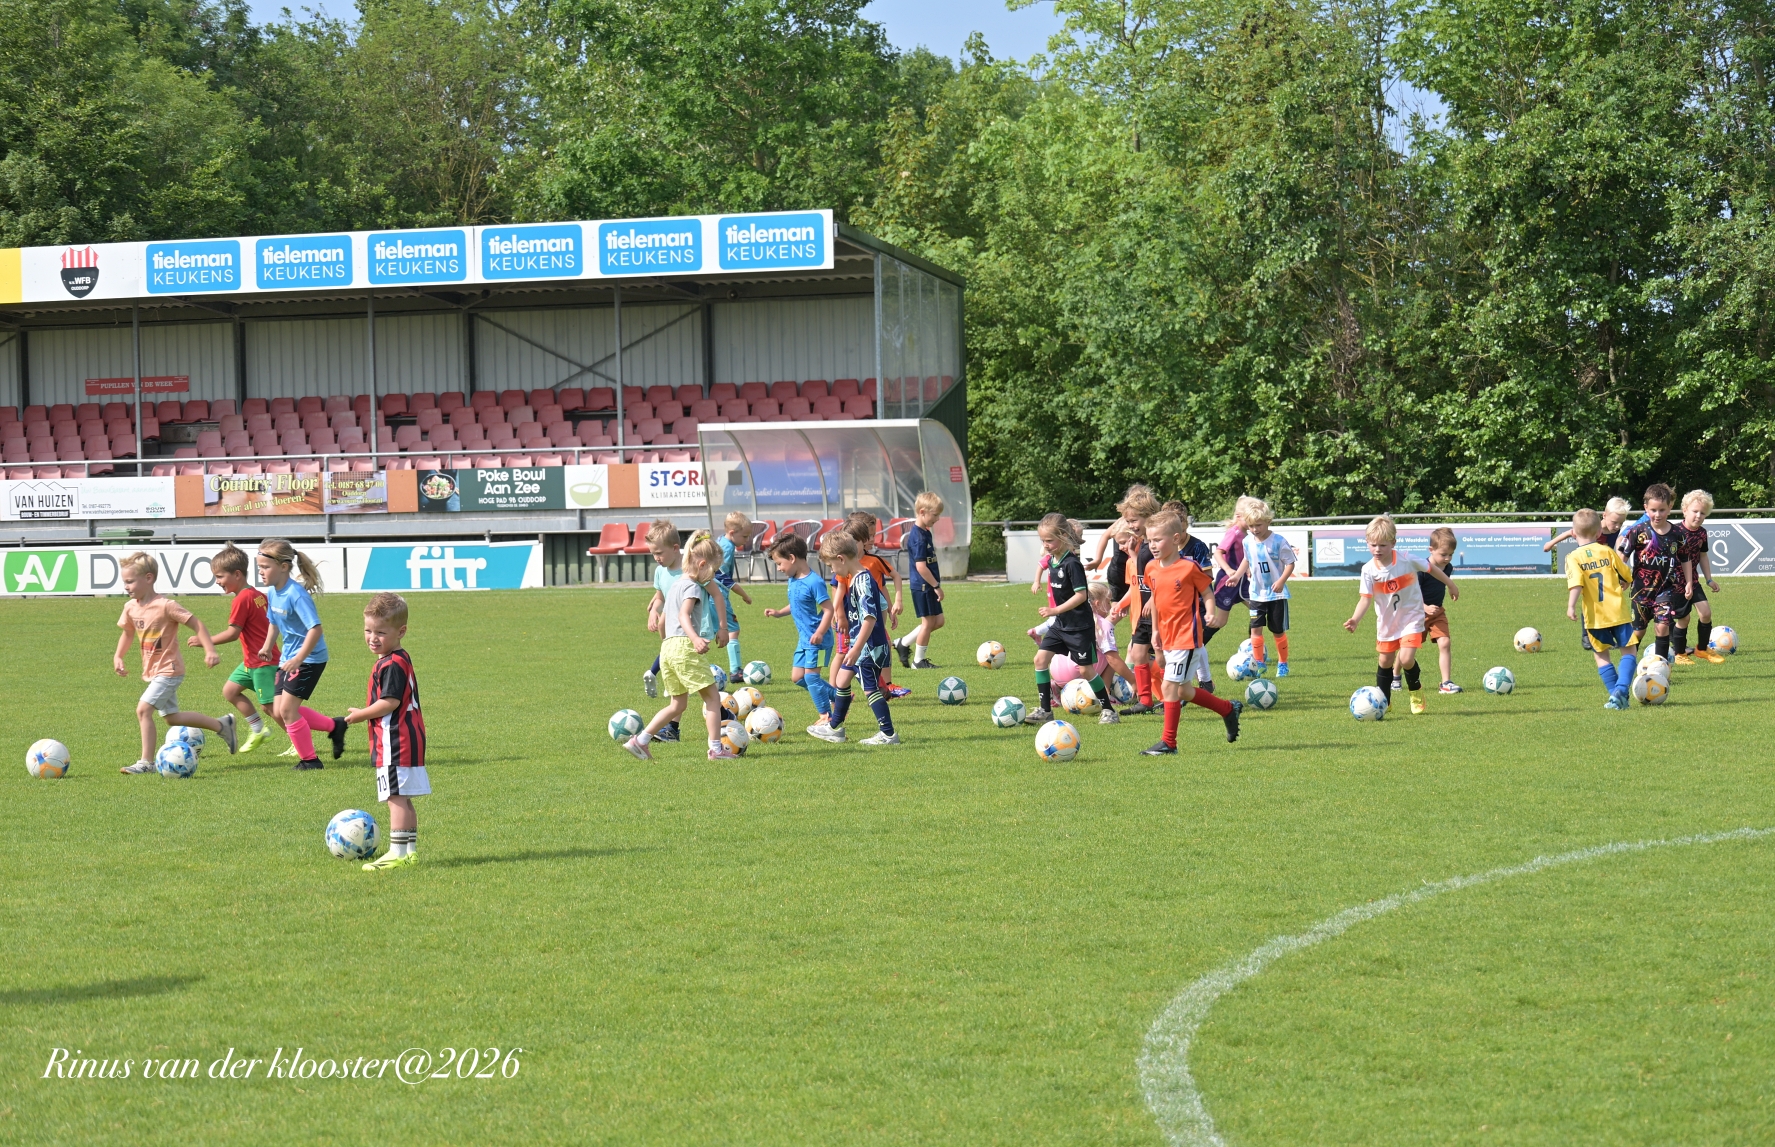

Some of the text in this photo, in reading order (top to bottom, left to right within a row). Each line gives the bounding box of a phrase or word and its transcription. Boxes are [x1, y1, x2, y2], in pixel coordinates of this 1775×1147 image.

[606, 229, 693, 249] tieleman
[726, 223, 814, 244] tieleman
[374, 240, 458, 259] tieleman
[488, 234, 574, 254] tieleman
[728, 243, 816, 261] KEUKENS
[153, 250, 232, 269] tieleman
[263, 245, 344, 264] tieleman
[490, 254, 575, 271] KEUKENS
[608, 249, 694, 266] KEUKENS
[264, 264, 345, 280] KEUKENS
[376, 260, 459, 276] KEUKENS
[154, 269, 234, 285] KEUKENS
[477, 468, 546, 482] Poke Bowl
[210, 473, 318, 495] Country Floor
[355, 480, 364, 489] 68
[484, 481, 541, 495] Aan Zee
[14, 494, 74, 508] VAN HUIZEN
[222, 490, 306, 514] Voor al uw vloeren!
[496, 496, 507, 504] PAD
[651, 491, 718, 499] KLIMAATTECHNEK
[406, 546, 487, 589] fitr
[1258, 561, 1271, 574] 10
[1589, 572, 1604, 602] 7
[1173, 662, 1184, 676] 10
[377, 774, 388, 793] 10
